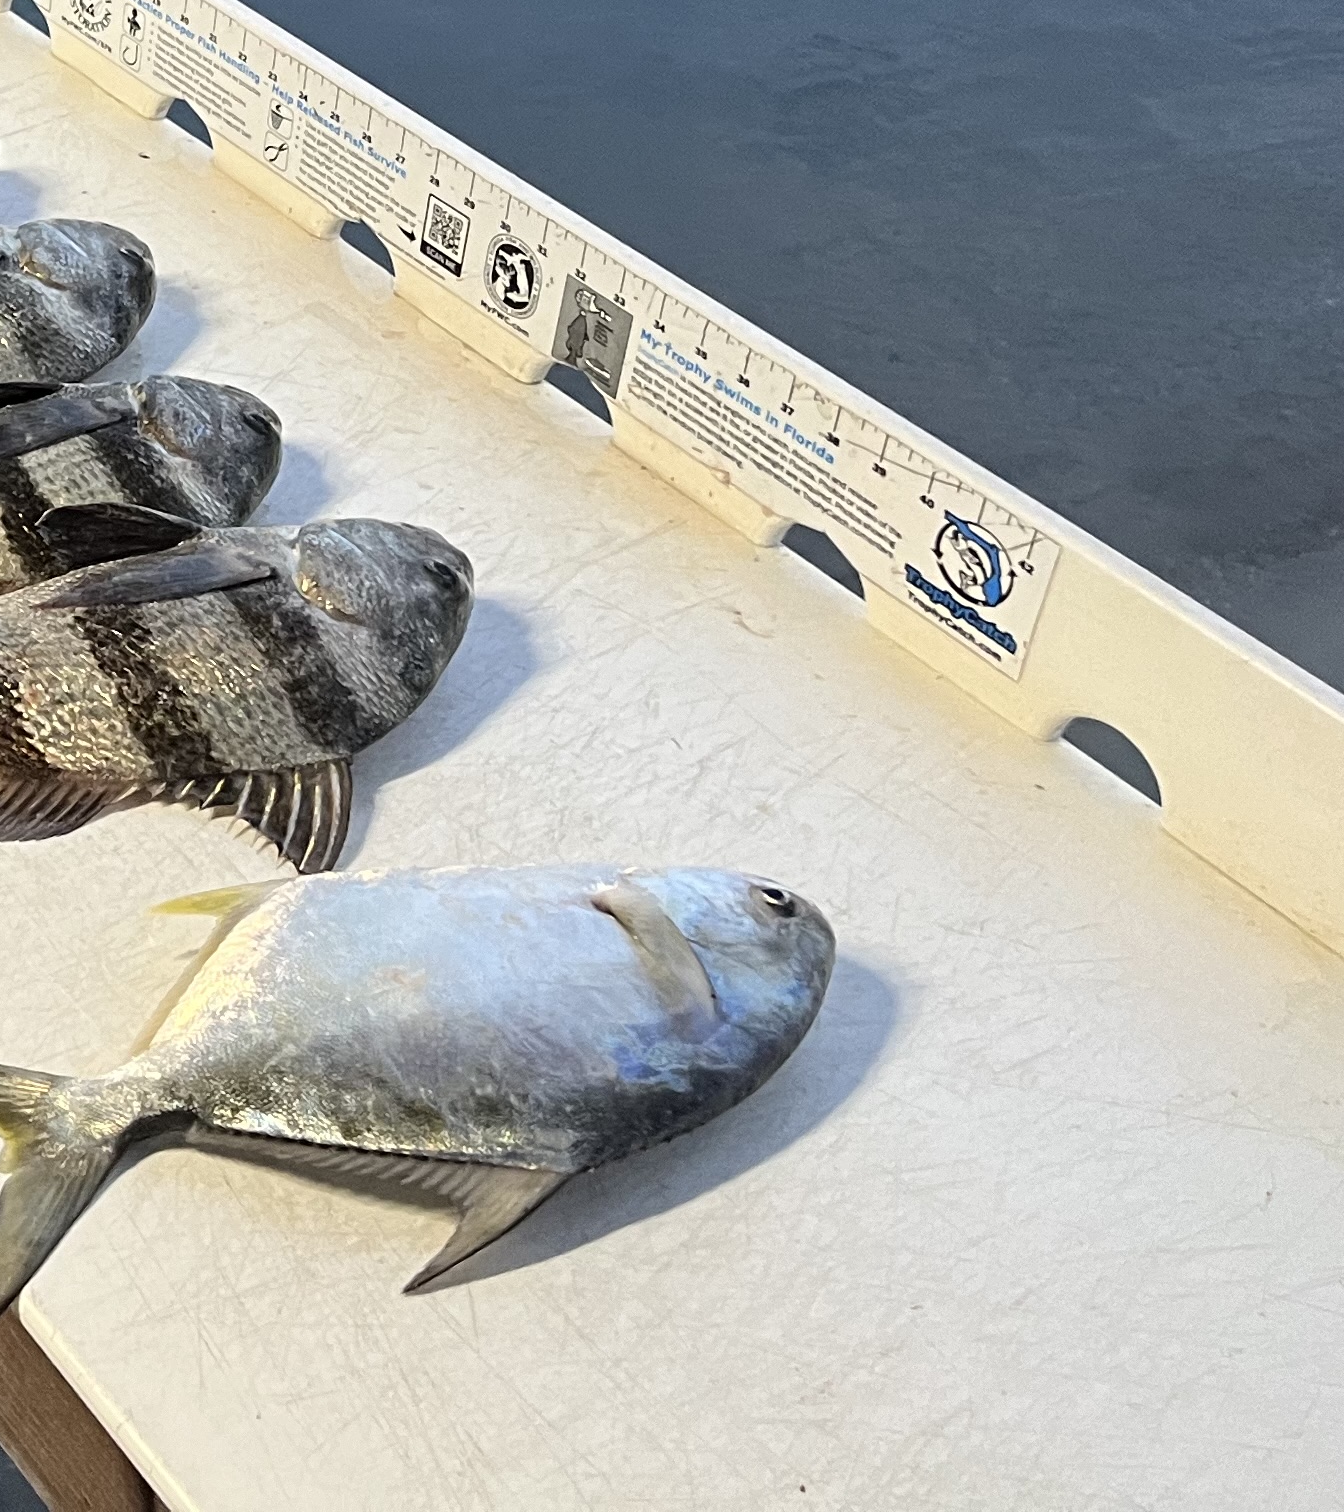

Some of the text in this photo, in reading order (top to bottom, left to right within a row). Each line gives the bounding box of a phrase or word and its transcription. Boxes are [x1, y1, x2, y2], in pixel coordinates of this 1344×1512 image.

[165, 13, 195, 40] Proper
[219, 49, 260, 85] Handling
[272, 83, 294, 105] Help
[343, 131, 364, 151] Fish
[367, 146, 407, 179] Survive
[640, 328, 662, 350] My
[714, 378, 762, 416] Swims
[765, 409, 779, 428] in
[784, 423, 835, 465] Florida
